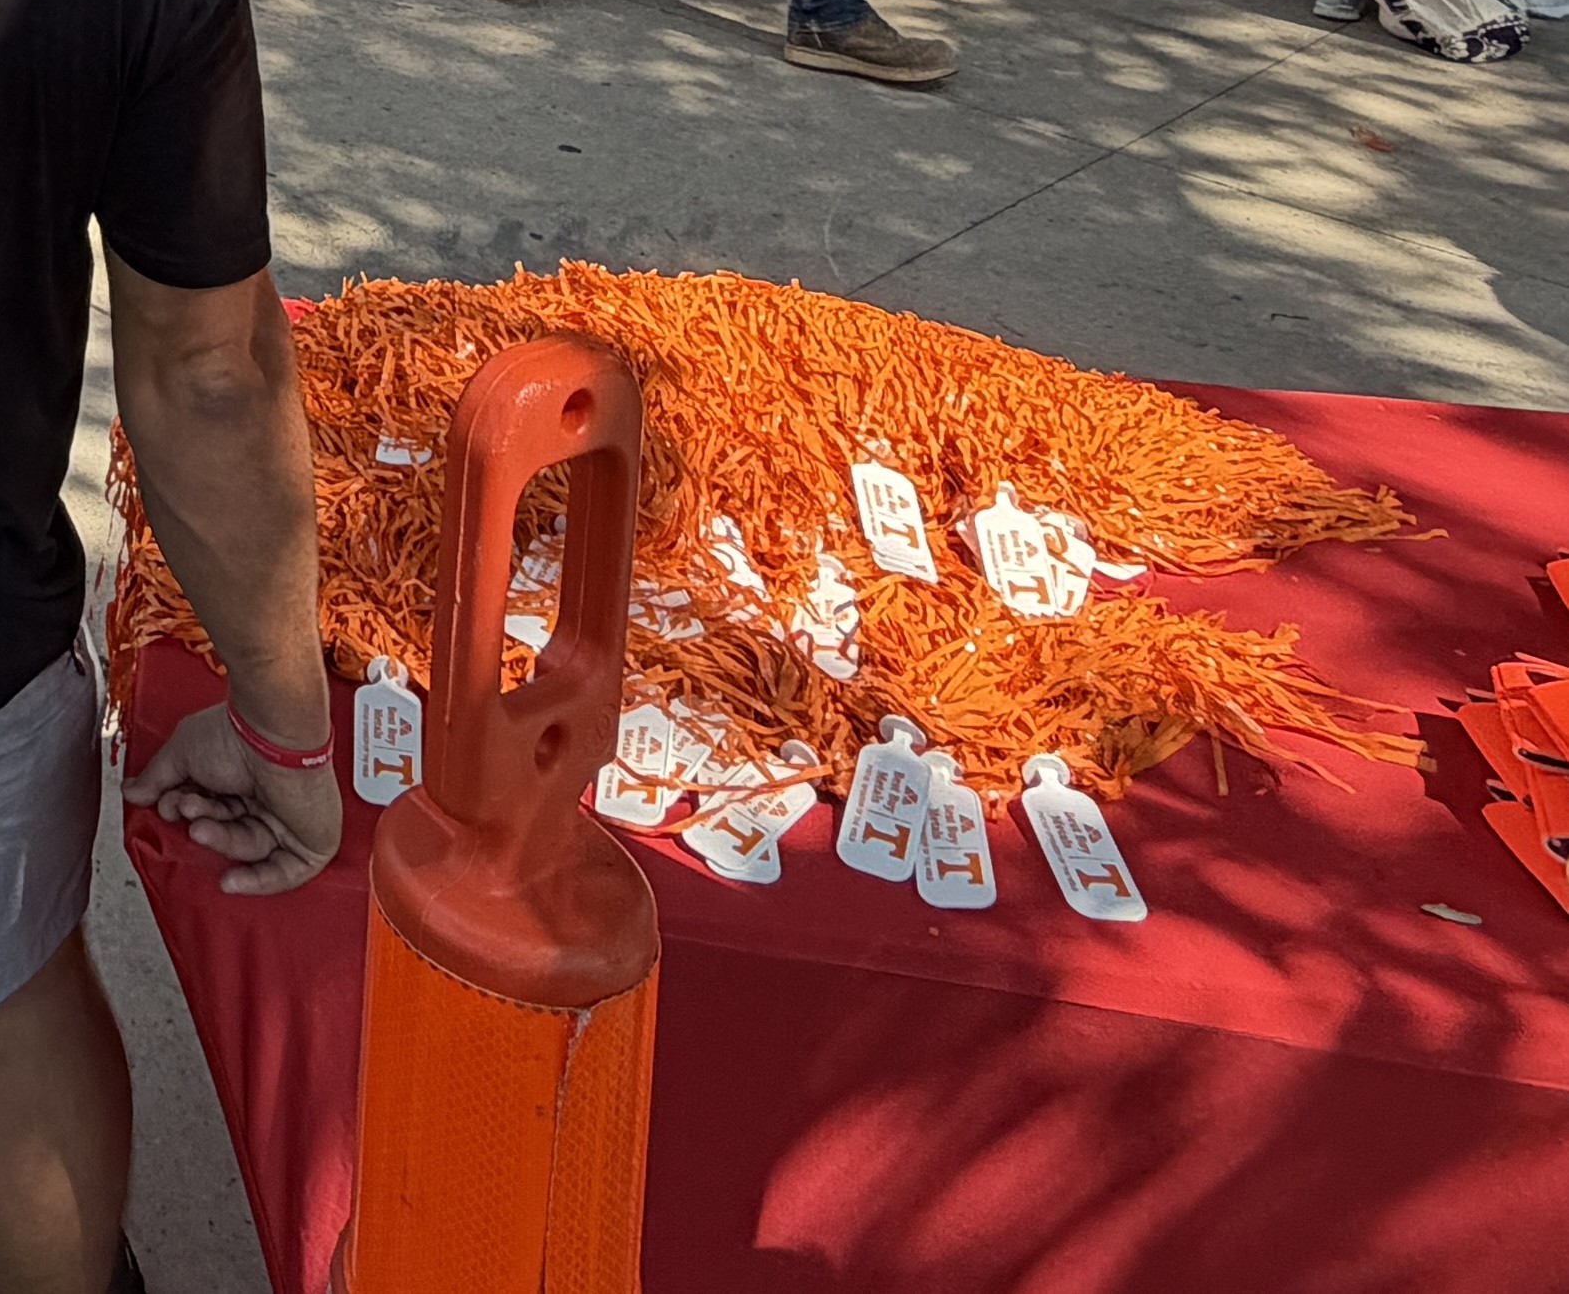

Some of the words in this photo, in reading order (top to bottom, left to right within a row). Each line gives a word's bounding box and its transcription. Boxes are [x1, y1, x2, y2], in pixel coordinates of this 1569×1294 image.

[880, 521, 920, 549] T
[1007, 576, 1050, 605] T
[622, 729, 633, 759] Metals
[636, 726, 648, 745] Best
[374, 755, 414, 786] T
[631, 747, 644, 765] Buy
[871, 770, 888, 803] Metals
[891, 771, 905, 792] Best
[884, 793, 900, 814] Buy
[944, 804, 955, 823] Best
[711, 816, 765, 856] T
[929, 807, 943, 840] Metals
[947, 826, 959, 845] Buy
[862, 822, 910, 861] T
[937, 852, 983, 885] T
[1075, 863, 1132, 898] T
